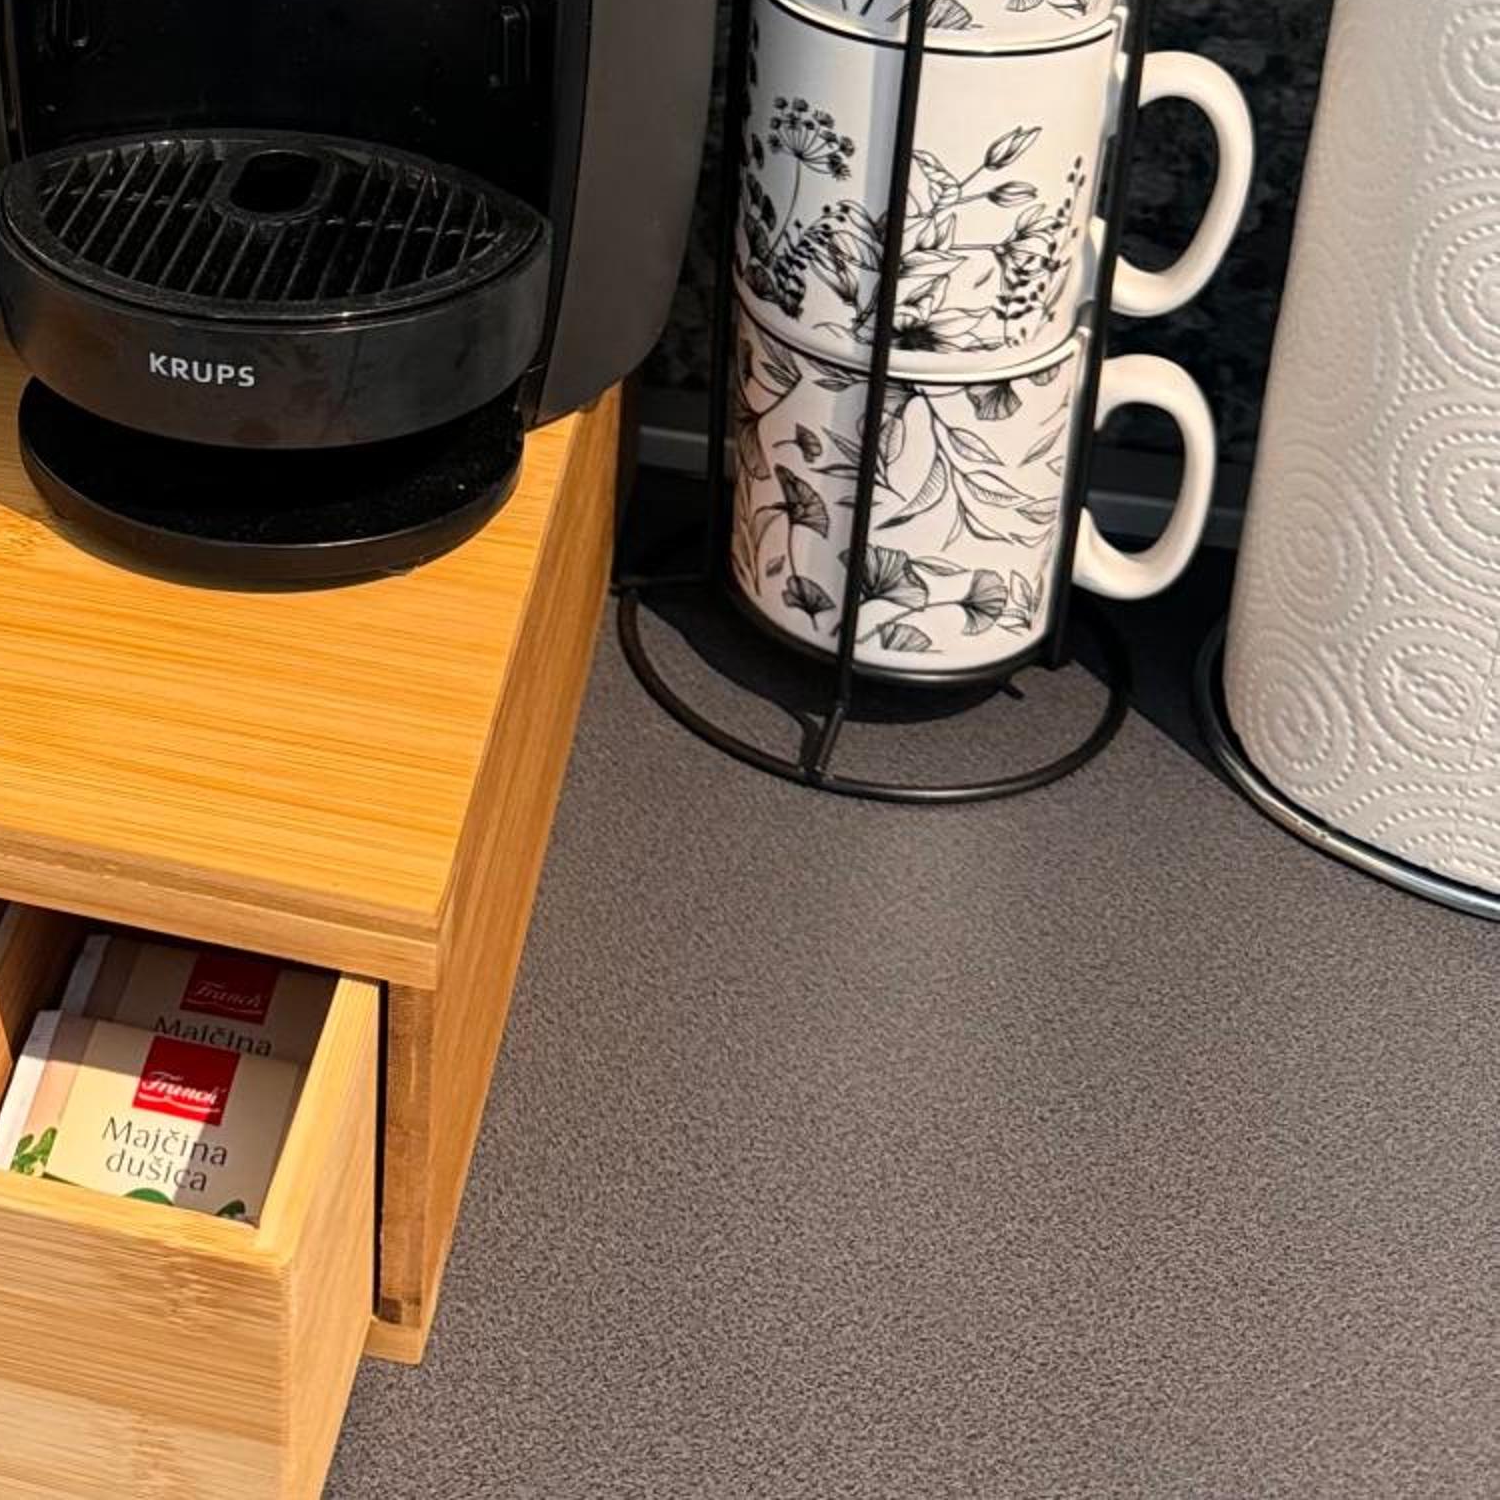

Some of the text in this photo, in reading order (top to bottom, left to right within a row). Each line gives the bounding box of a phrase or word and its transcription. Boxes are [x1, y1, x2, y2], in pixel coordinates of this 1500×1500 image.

[149, 352, 255, 387] KRUPS
[141, 1071, 218, 1105] Franck
[101, 1116, 228, 1167] Majčina
[105, 1148, 207, 1192] dušica
